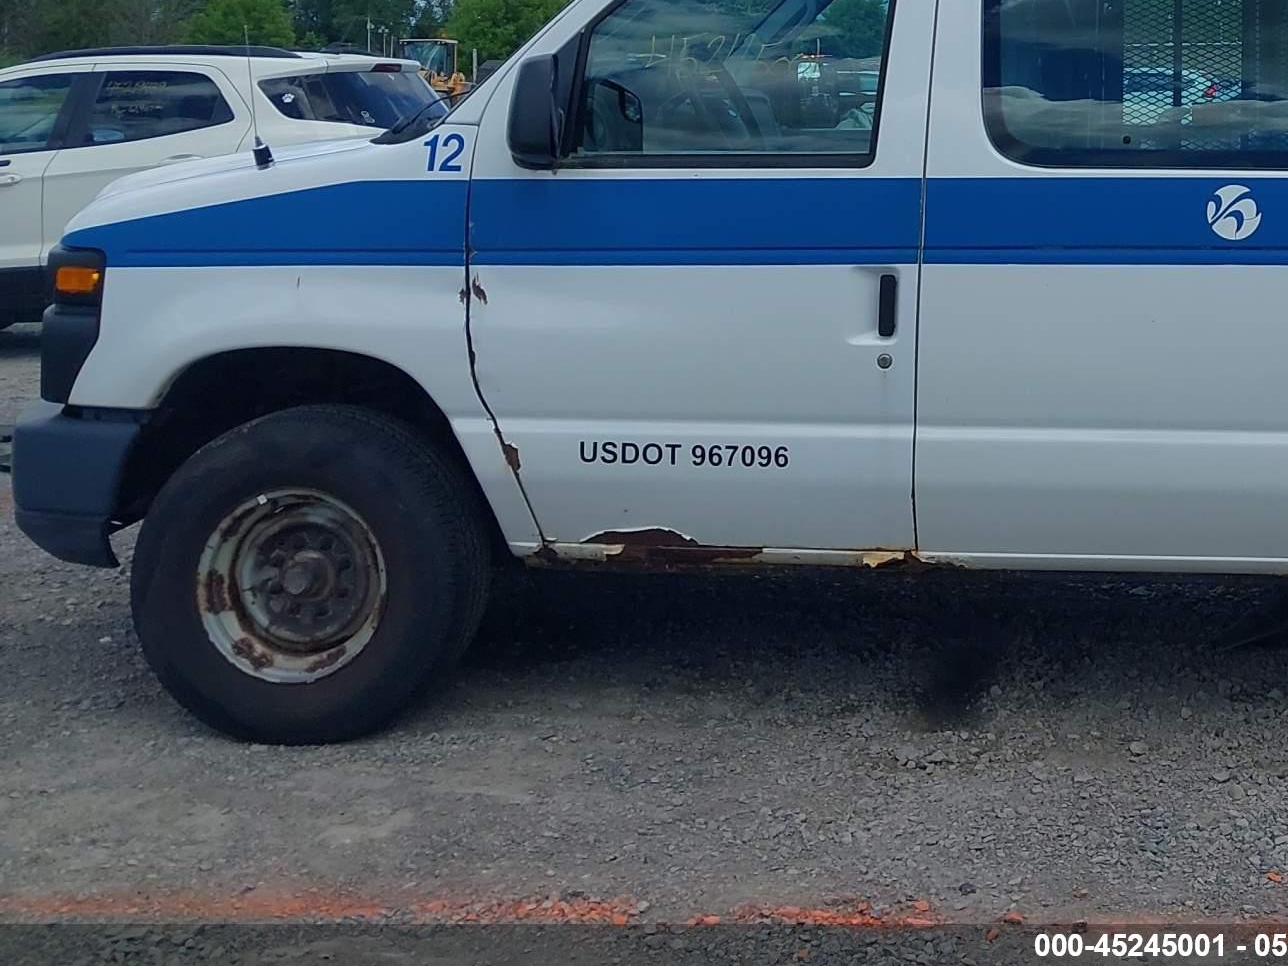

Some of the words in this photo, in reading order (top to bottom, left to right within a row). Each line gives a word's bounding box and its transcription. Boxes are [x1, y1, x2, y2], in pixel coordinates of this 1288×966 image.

[423, 133, 465, 172] 12
[579, 441, 682, 466] USDOT
[691, 444, 790, 468] 967096
